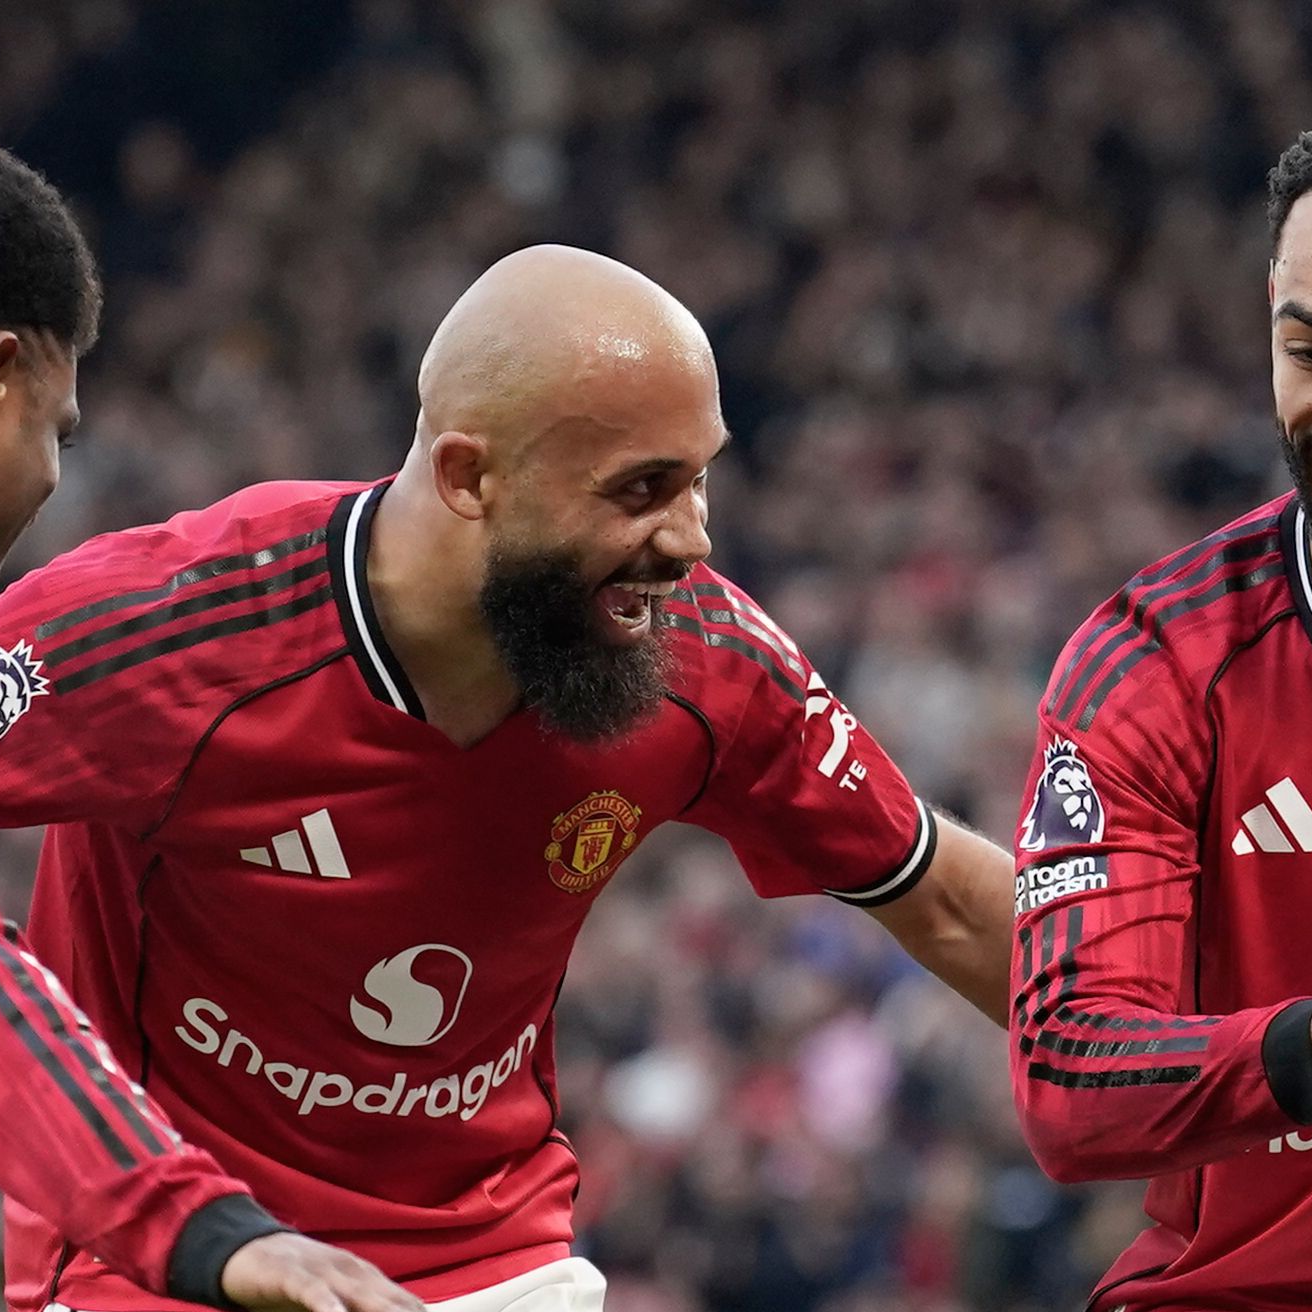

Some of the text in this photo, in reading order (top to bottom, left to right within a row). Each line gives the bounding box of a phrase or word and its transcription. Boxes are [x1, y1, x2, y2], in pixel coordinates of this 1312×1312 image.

[558, 798, 634, 834] MANCHESTER
[1027, 855, 1096, 888] room
[174, 997, 537, 1121] Snapdragon
